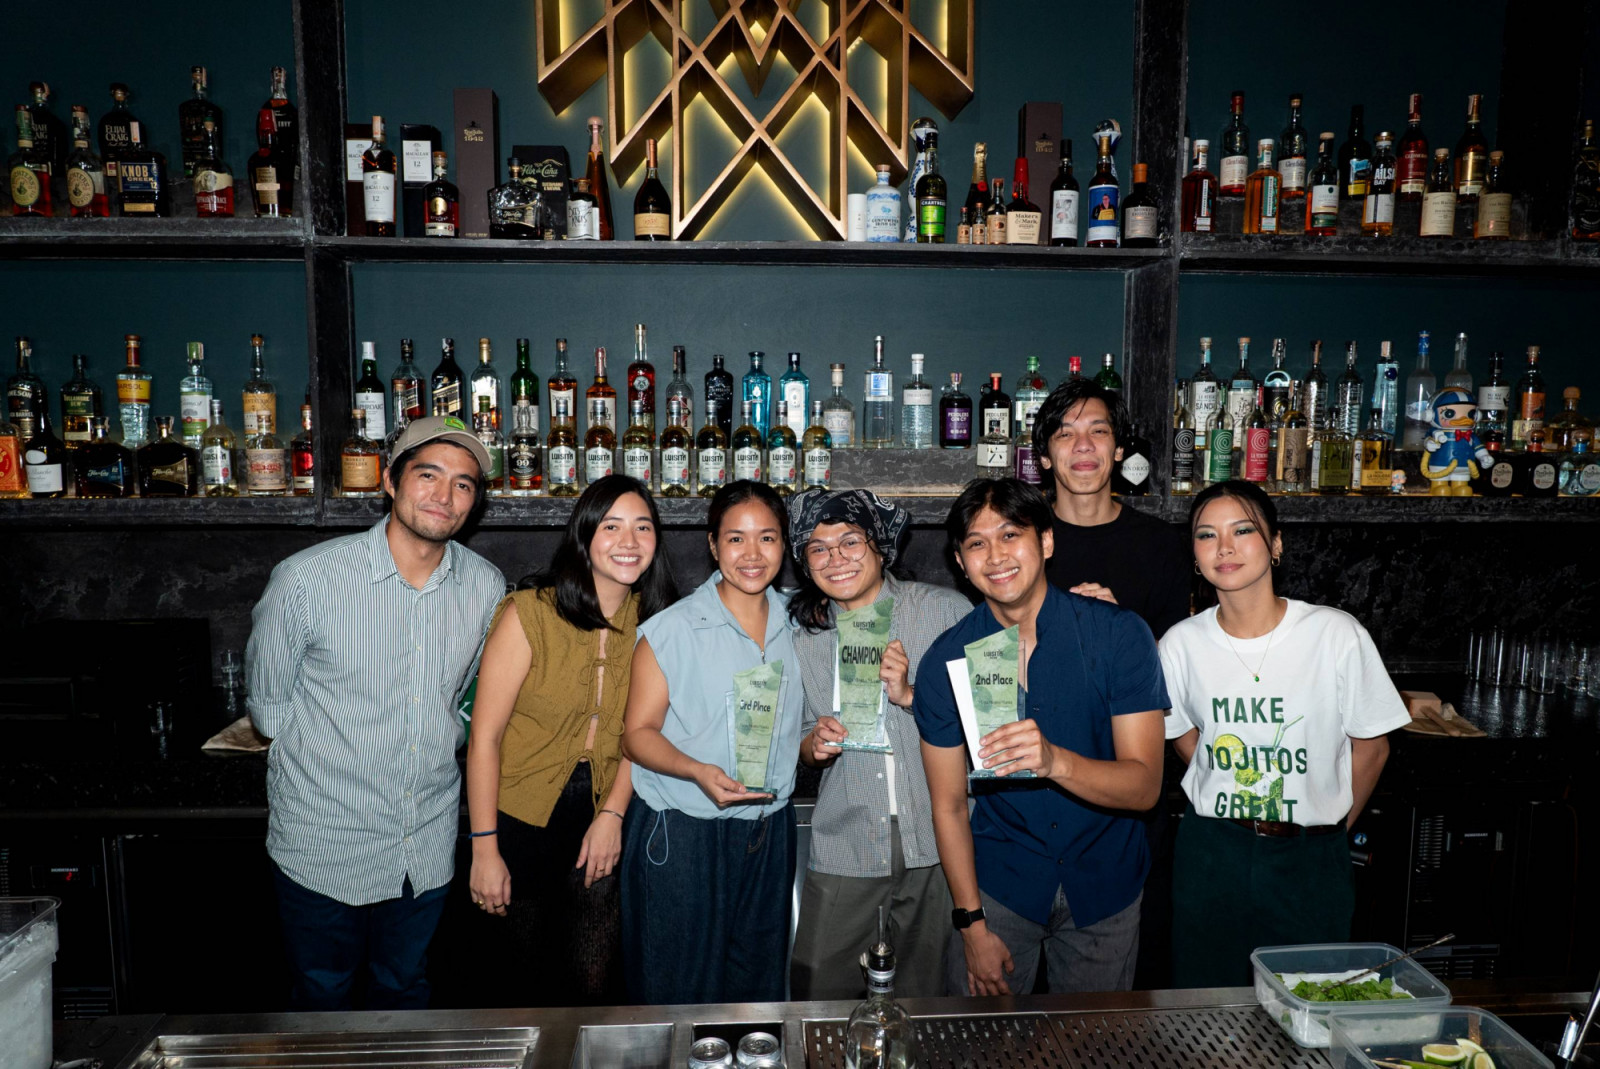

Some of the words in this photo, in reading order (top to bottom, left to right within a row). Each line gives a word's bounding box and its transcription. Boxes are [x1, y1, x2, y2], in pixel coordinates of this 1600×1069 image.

[105, 133, 129, 142] CRAIG
[121, 164, 149, 177] KNOB
[516, 459, 530, 467] 99
[841, 645, 883, 666] CHAMPION
[975, 673, 991, 686] 2nd
[992, 673, 1013, 686] Place
[740, 699, 752, 711] 3rd
[1212, 697, 1285, 723] MAKE
[1214, 791, 1298, 823] GREAT
